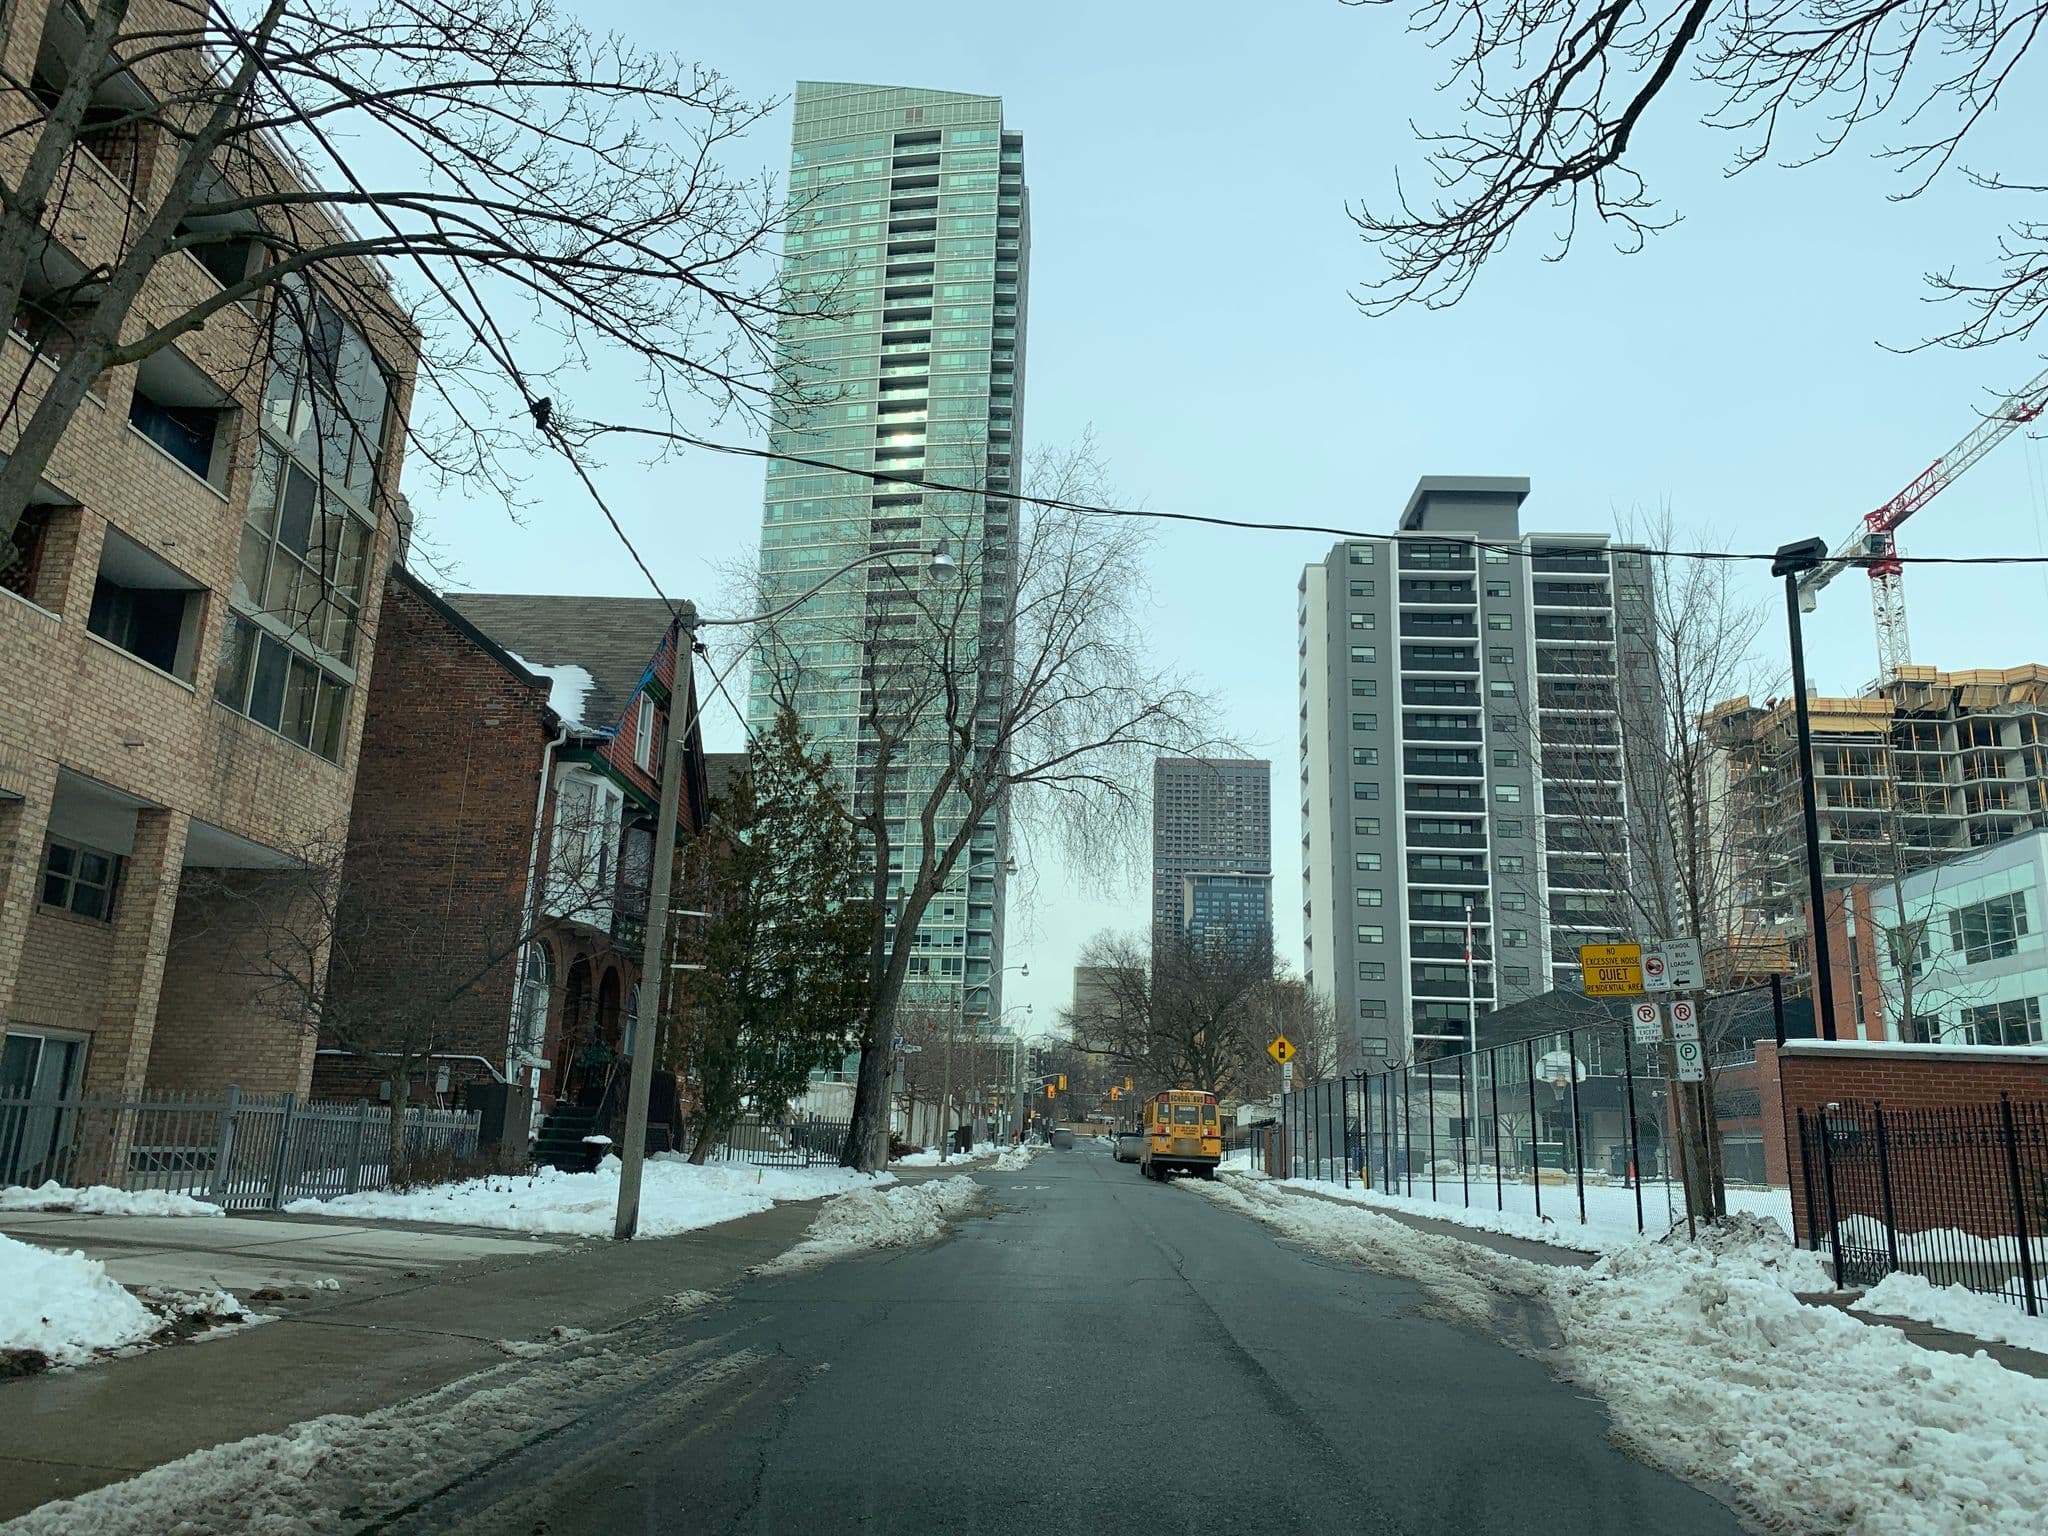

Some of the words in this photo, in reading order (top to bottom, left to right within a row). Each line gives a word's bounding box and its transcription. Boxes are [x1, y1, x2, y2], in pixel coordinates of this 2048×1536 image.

[1667, 942, 1690, 950] SCHOOL
[1606, 947, 1616, 955] NO
[1585, 958, 1618, 966] EXCESSIVE
[1620, 957, 1640, 965] NOISE
[1670, 960, 1694, 968] LOADING
[1599, 968, 1628, 981] QUIET
[1587, 984, 1626, 992] RESIDENTIAL
